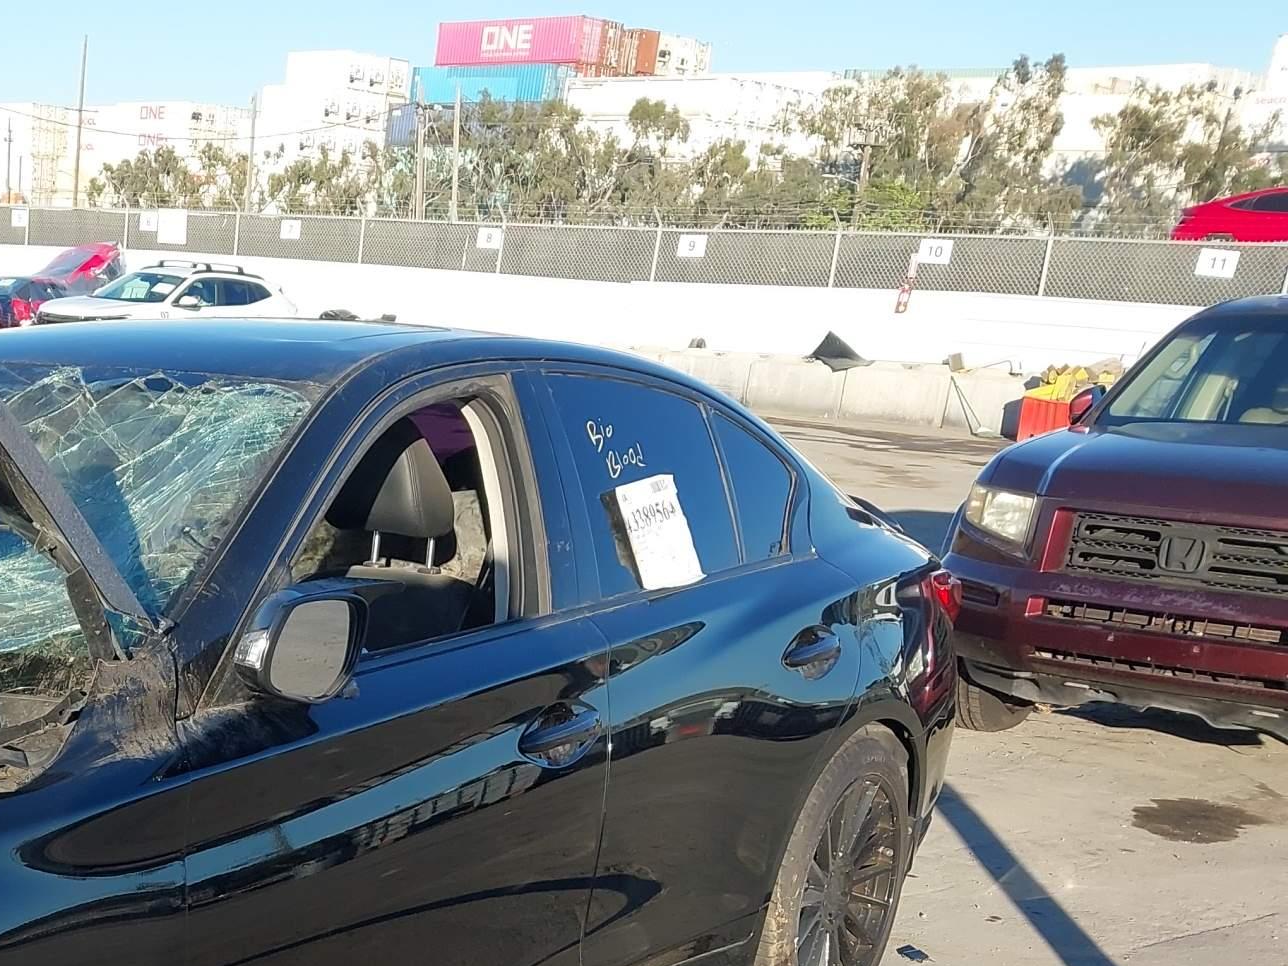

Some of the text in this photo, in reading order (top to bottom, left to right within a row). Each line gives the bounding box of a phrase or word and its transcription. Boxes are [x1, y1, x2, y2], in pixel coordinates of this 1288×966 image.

[480, 24, 534, 50] ONE
[140, 105, 166, 120] ONE
[138, 132, 165, 147] ONE
[485, 233, 493, 243] 8
[688, 241, 697, 252] 9
[928, 246, 944, 258] 10
[1210, 256, 1228, 270] 11
[586, 417, 614, 453] Bio
[605, 442, 648, 479] Blood
